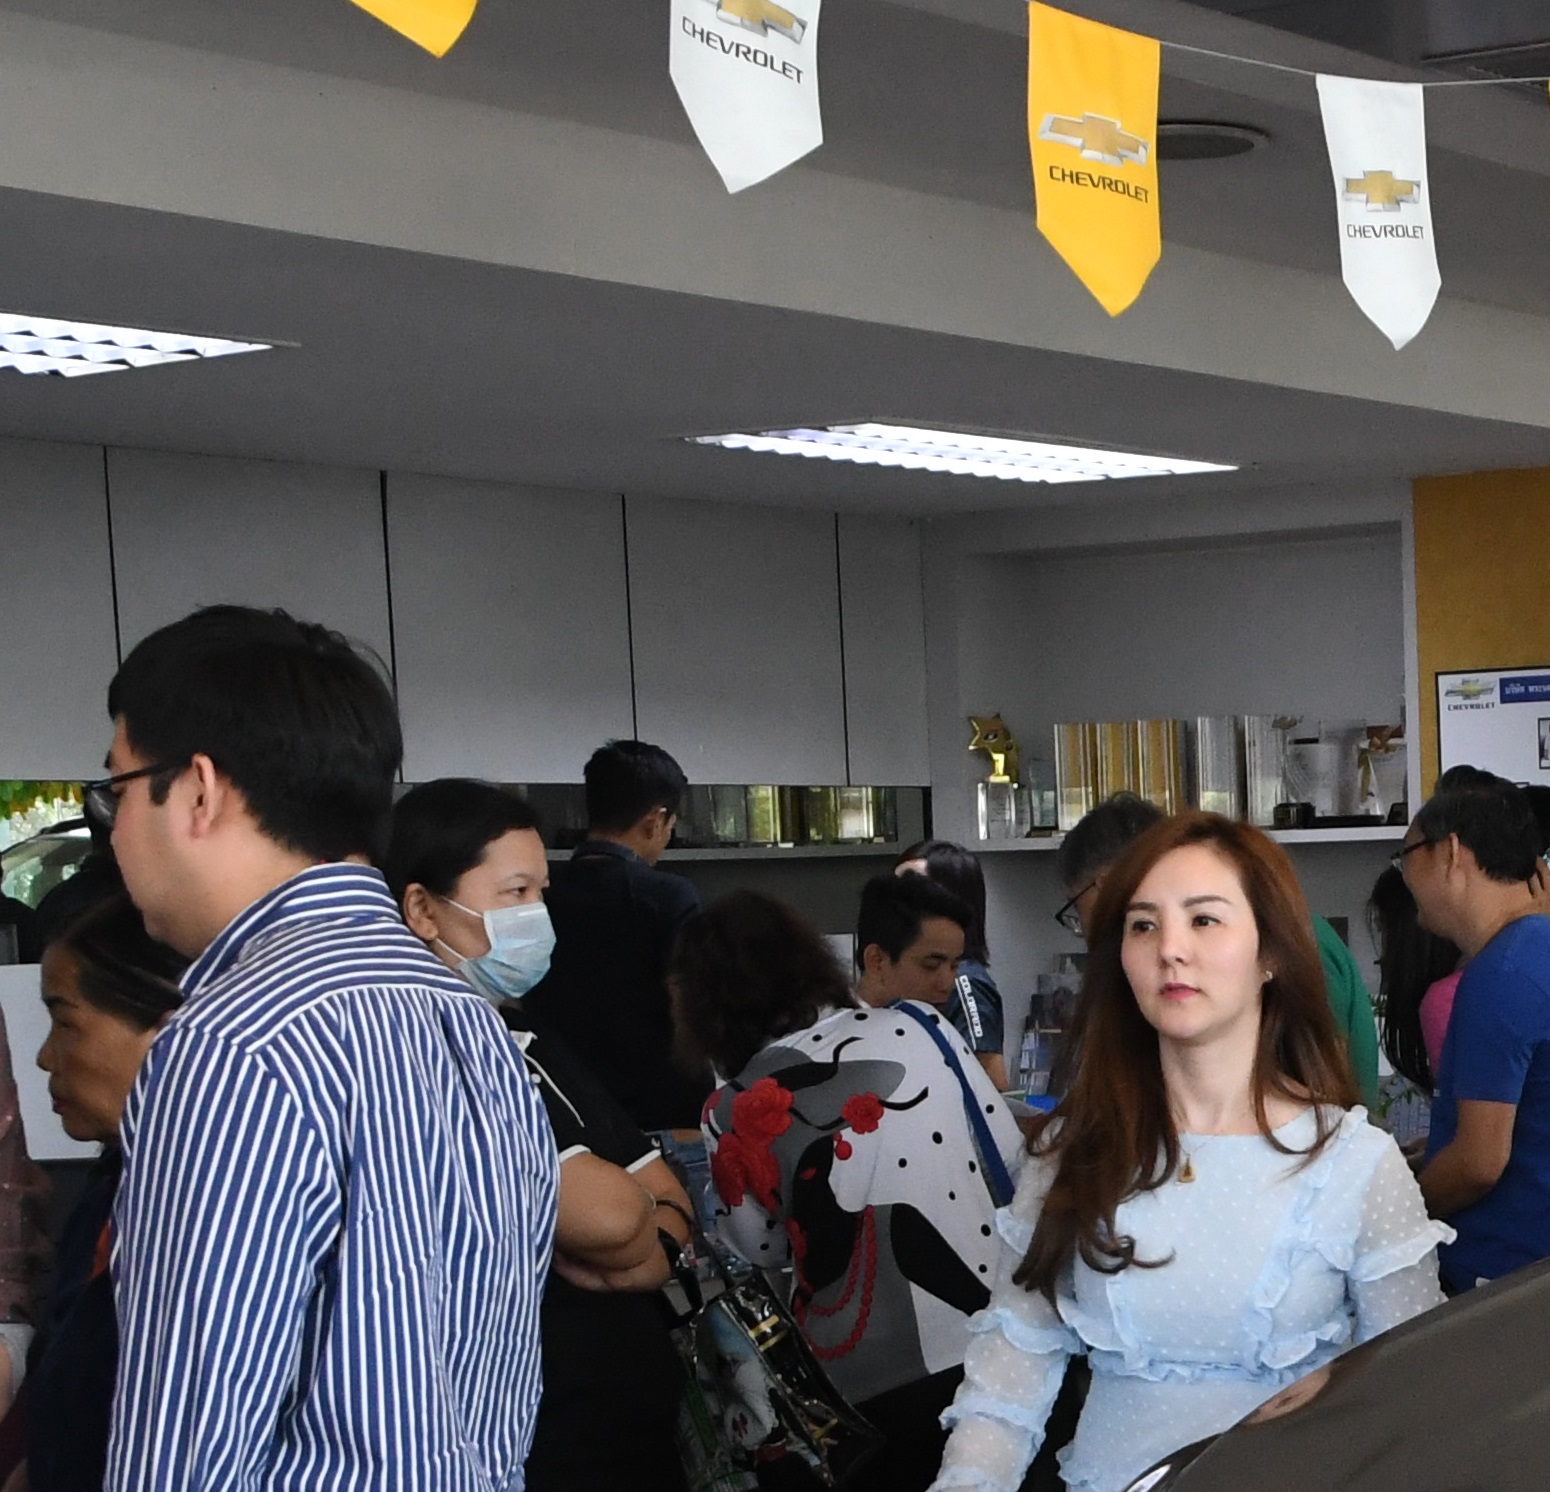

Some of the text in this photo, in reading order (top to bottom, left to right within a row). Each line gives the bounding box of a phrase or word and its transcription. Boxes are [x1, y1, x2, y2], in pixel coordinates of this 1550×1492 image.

[682, 15, 804, 84] CHEVROLET
[1048, 164, 1150, 204] CHEVROLET
[1346, 223, 1424, 240] CHEVROLET
[1447, 701, 1496, 712] CHEVROLET
[959, 974, 984, 1038] COLORADO
